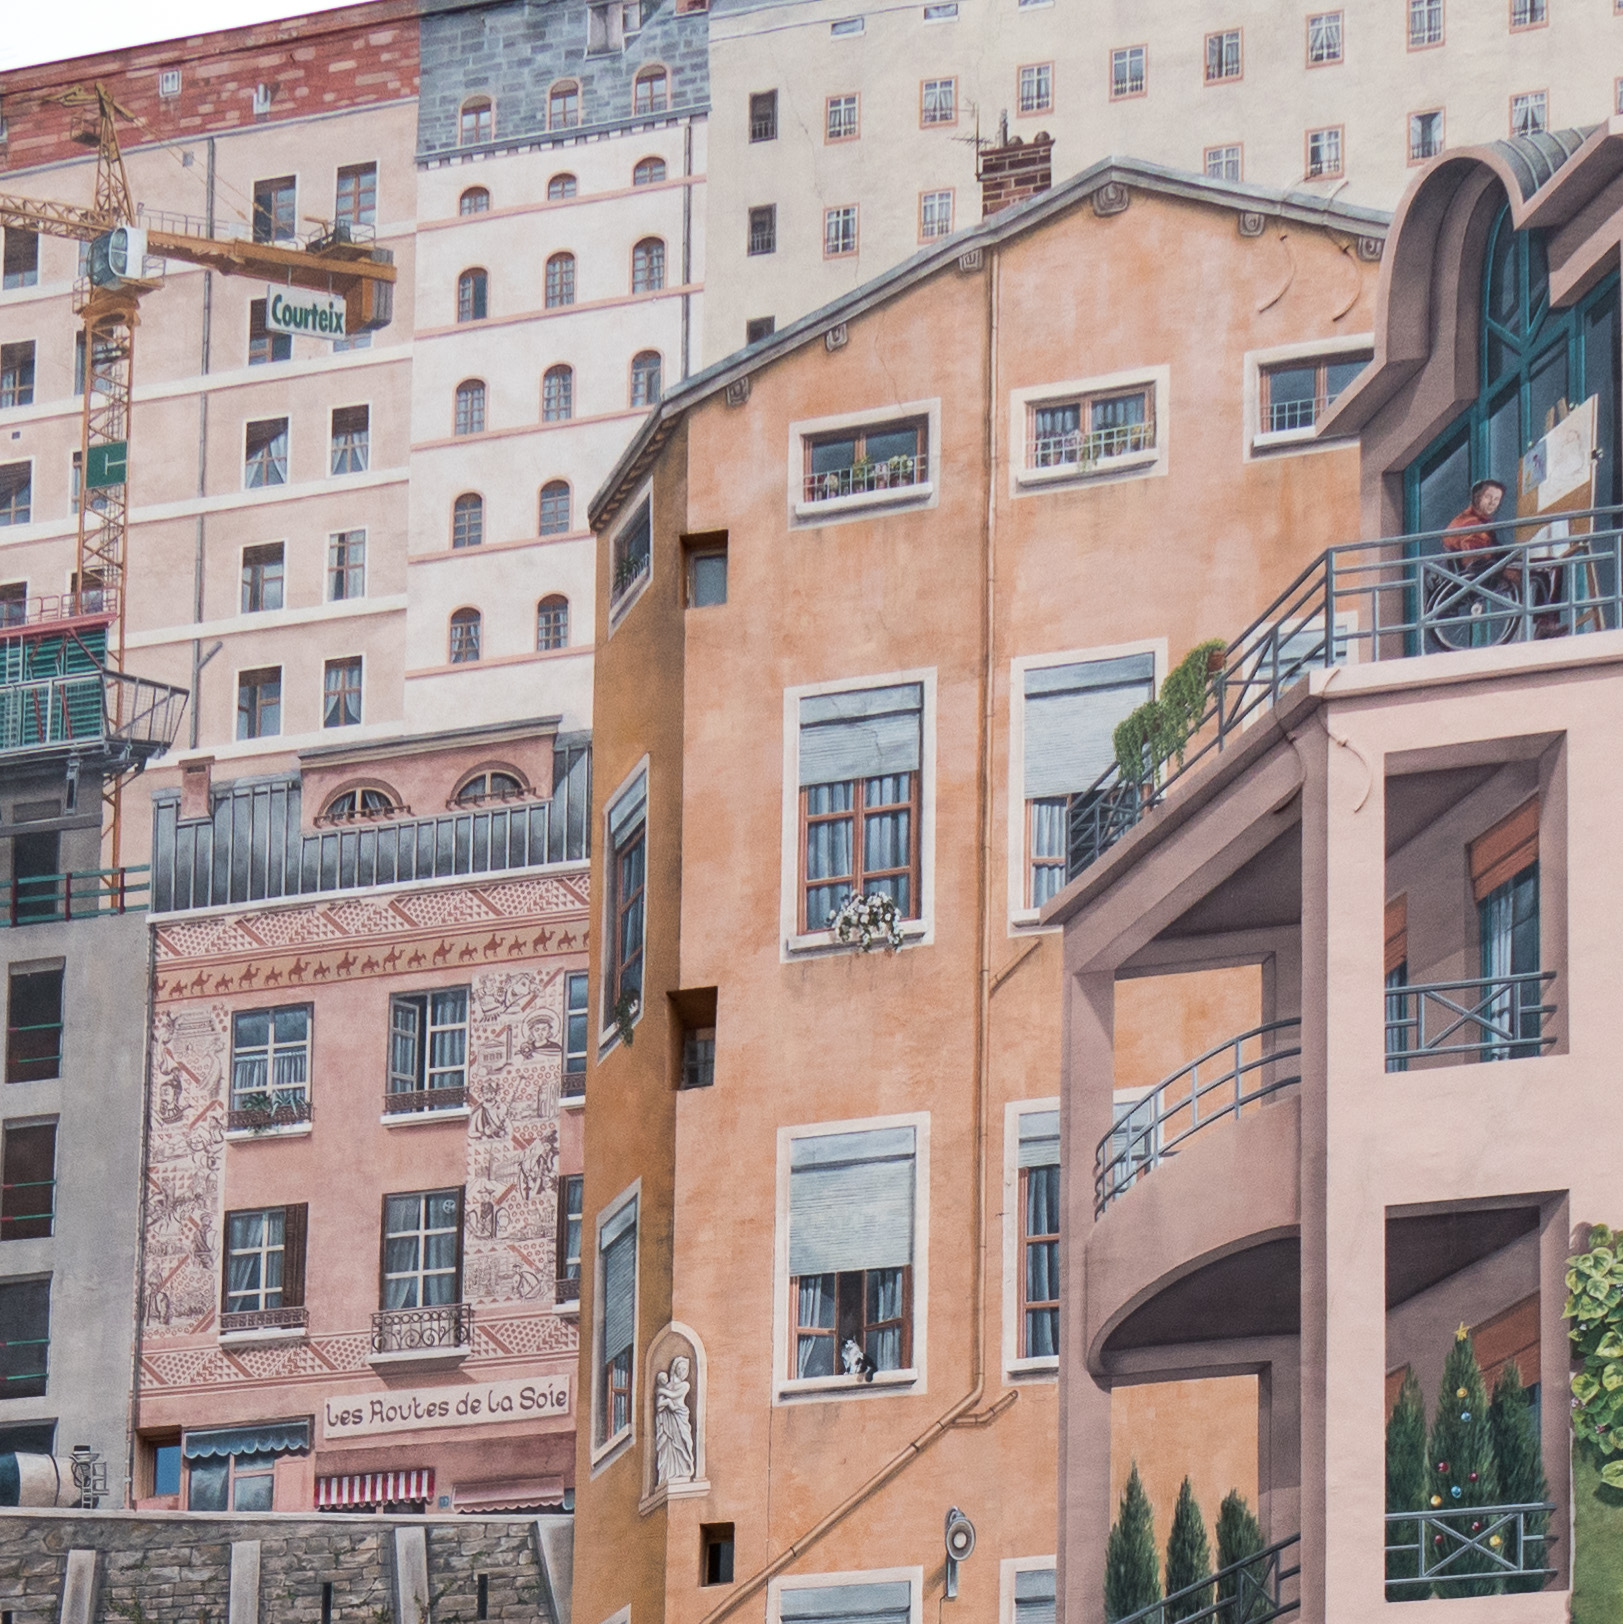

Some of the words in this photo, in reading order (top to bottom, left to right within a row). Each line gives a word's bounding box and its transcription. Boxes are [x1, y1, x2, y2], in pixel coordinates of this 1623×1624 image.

[271, 293, 344, 335] Courteix
[326, 1402, 364, 1427] Les
[369, 1396, 450, 1424] Routes
[456, 1391, 482, 1417] de
[487, 1390, 514, 1413] La
[519, 1382, 568, 1411] Soie
